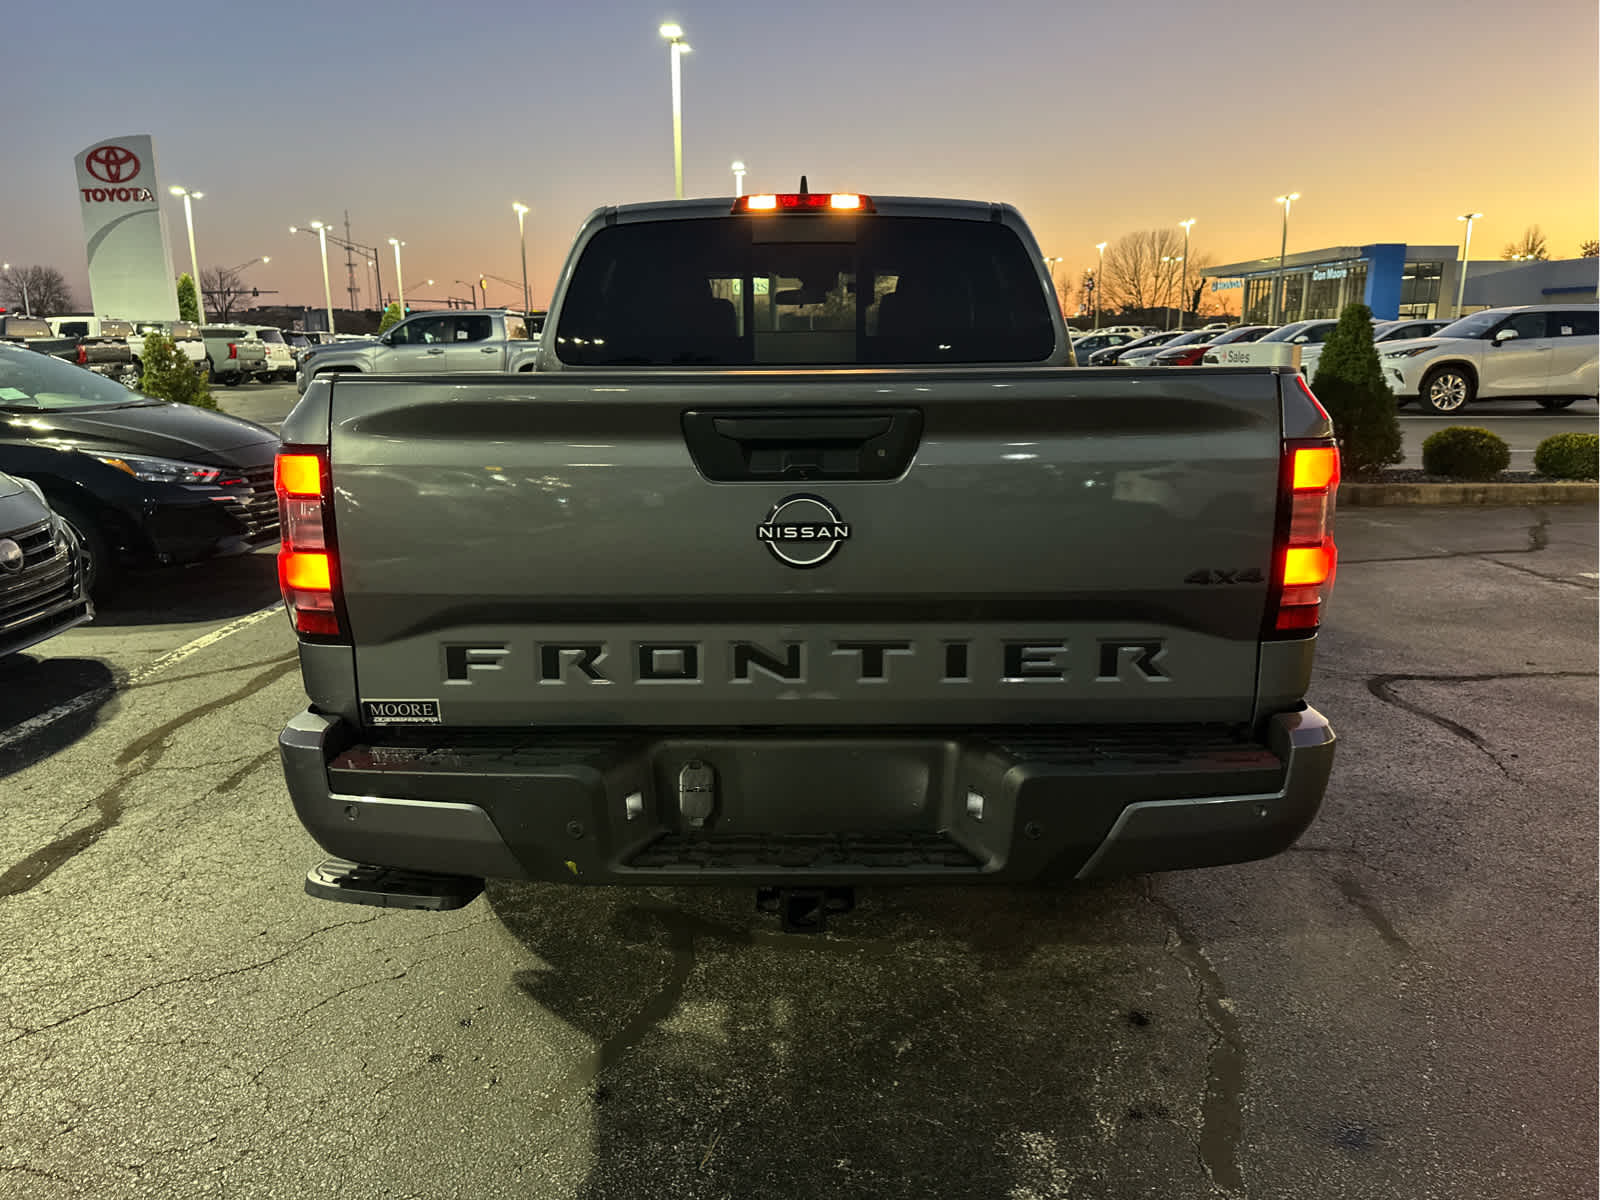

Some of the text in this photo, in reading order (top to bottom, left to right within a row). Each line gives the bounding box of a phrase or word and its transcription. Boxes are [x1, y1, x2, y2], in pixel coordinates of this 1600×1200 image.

[80, 187, 155, 203] TOYOTA
[1228, 351, 1250, 364] Sales
[758, 525, 849, 539] NISSAN
[441, 638, 1172, 686] FRONTIER
[369, 703, 434, 716] MOORE
